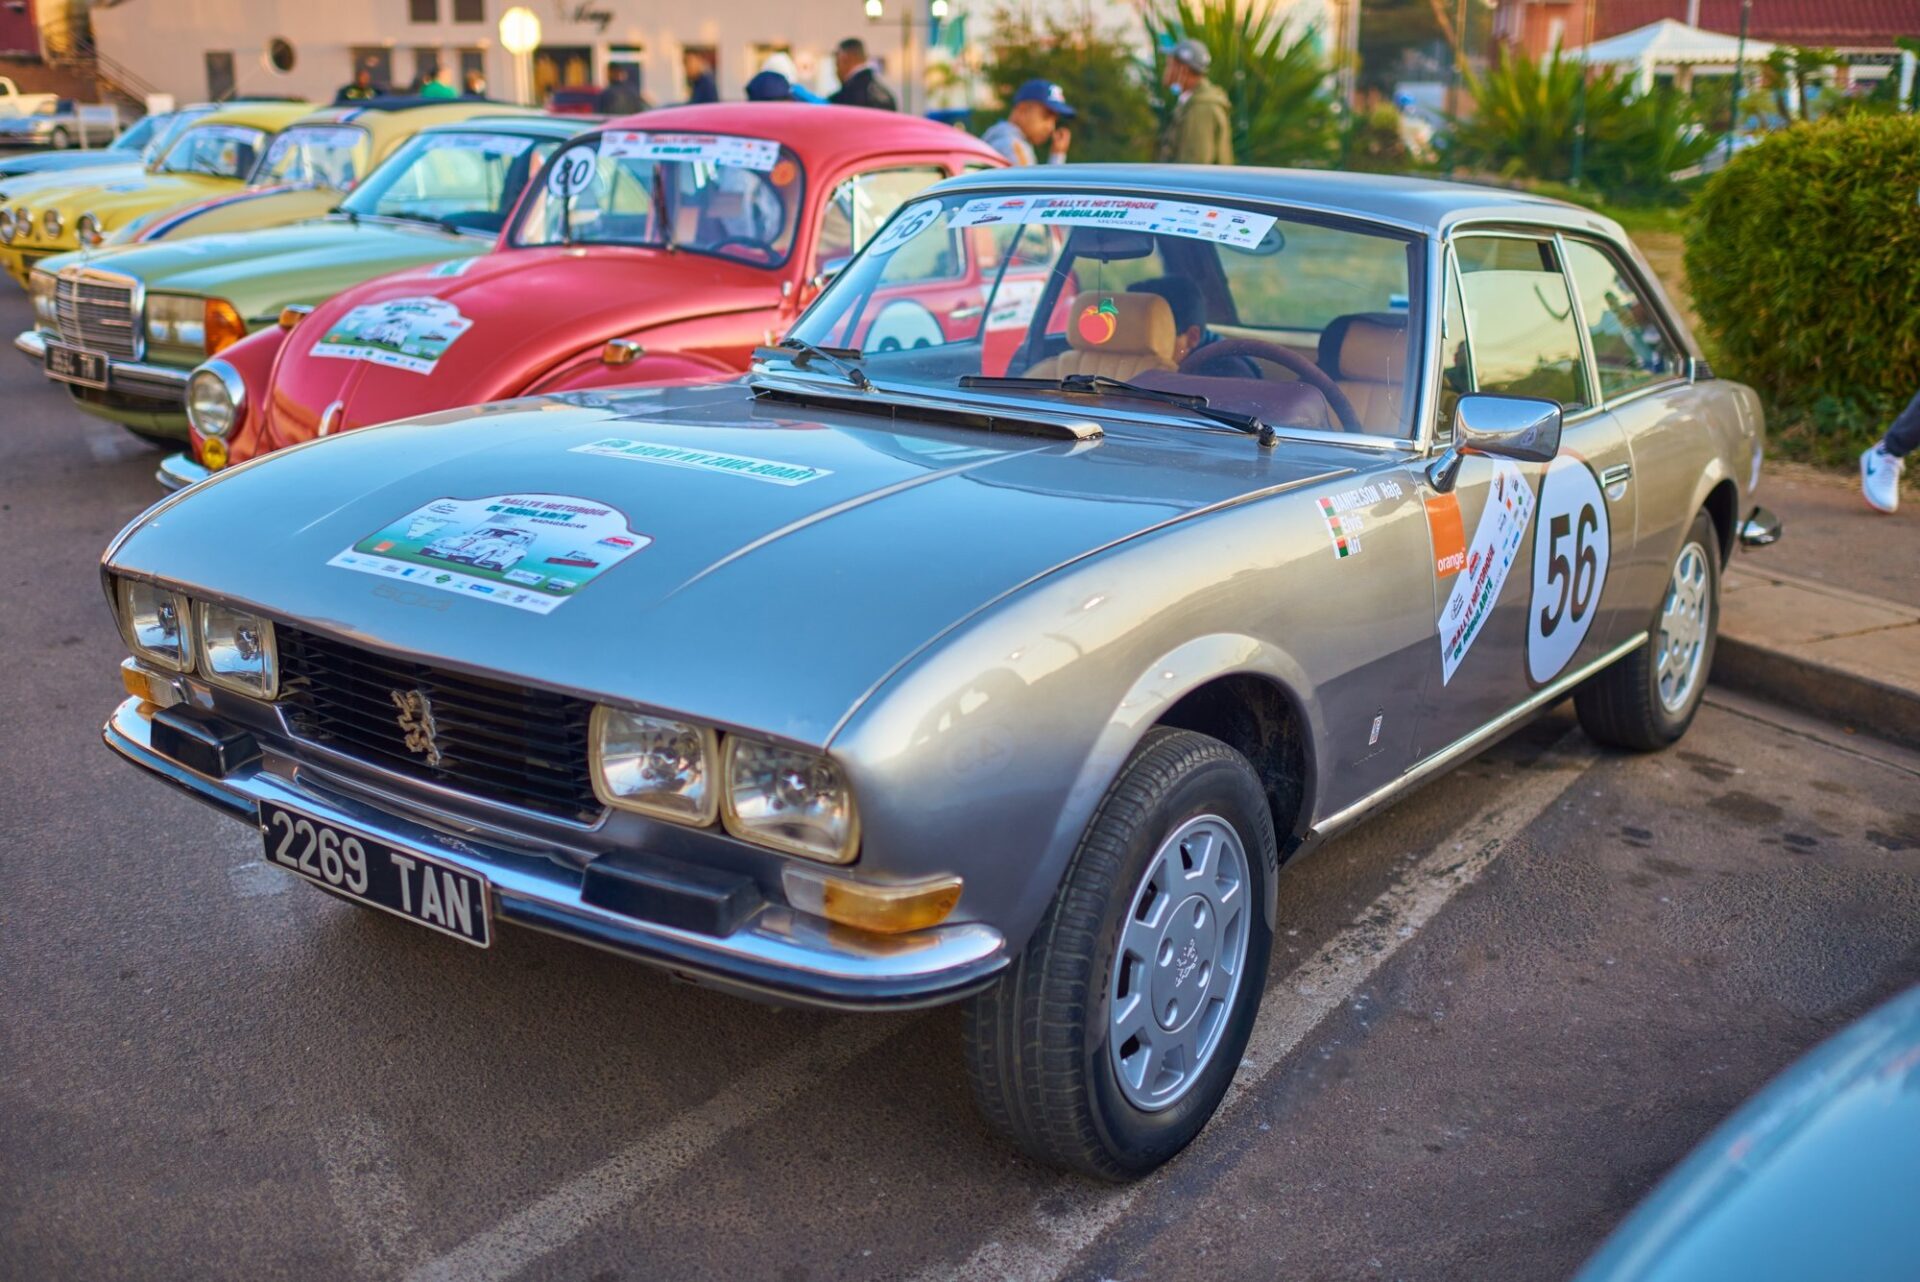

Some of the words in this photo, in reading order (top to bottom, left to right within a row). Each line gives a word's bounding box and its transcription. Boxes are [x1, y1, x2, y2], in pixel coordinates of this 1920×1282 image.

[879, 210, 934, 245] 56
[1437, 552, 1465, 573] orange
[1540, 502, 1599, 638] 56
[272, 810, 369, 895] 2269
[390, 852, 474, 937] TAN
